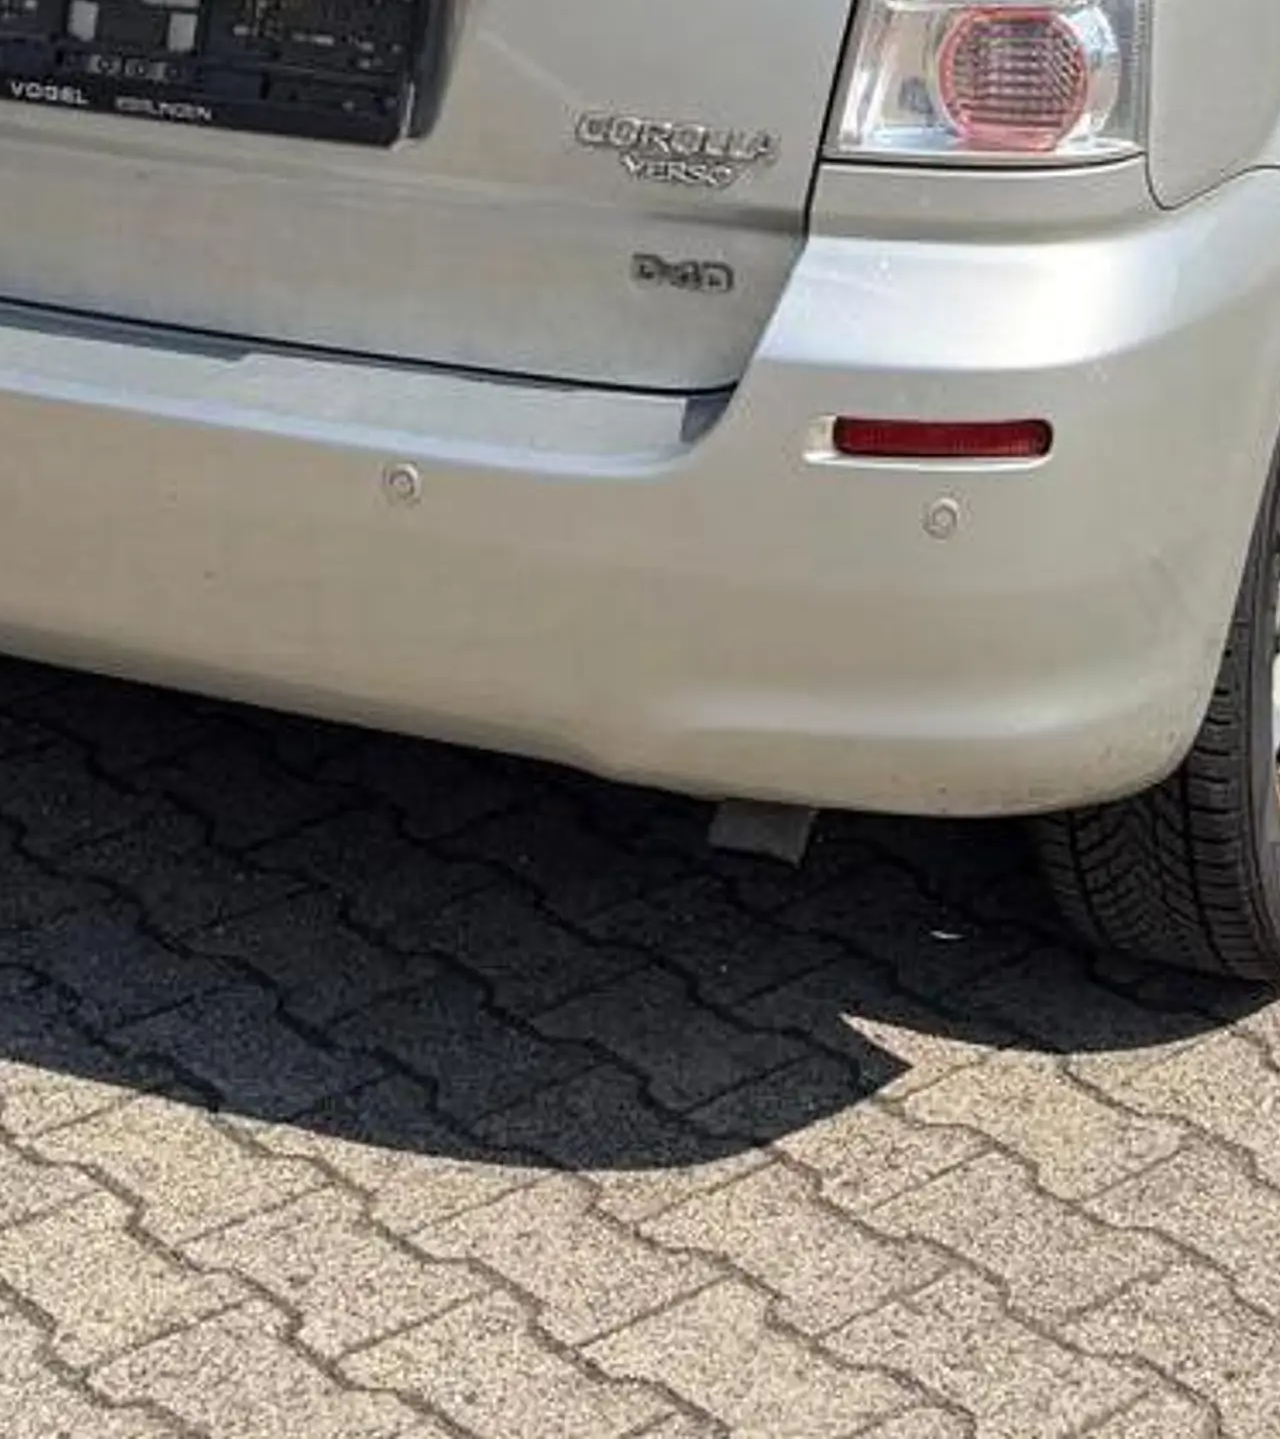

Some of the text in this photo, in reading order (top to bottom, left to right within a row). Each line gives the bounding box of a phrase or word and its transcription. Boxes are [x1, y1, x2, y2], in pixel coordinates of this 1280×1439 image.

[10, 80, 89, 106] VOGEL
[574, 112, 775, 163] COROLLA
[620, 153, 734, 189] VERSO
